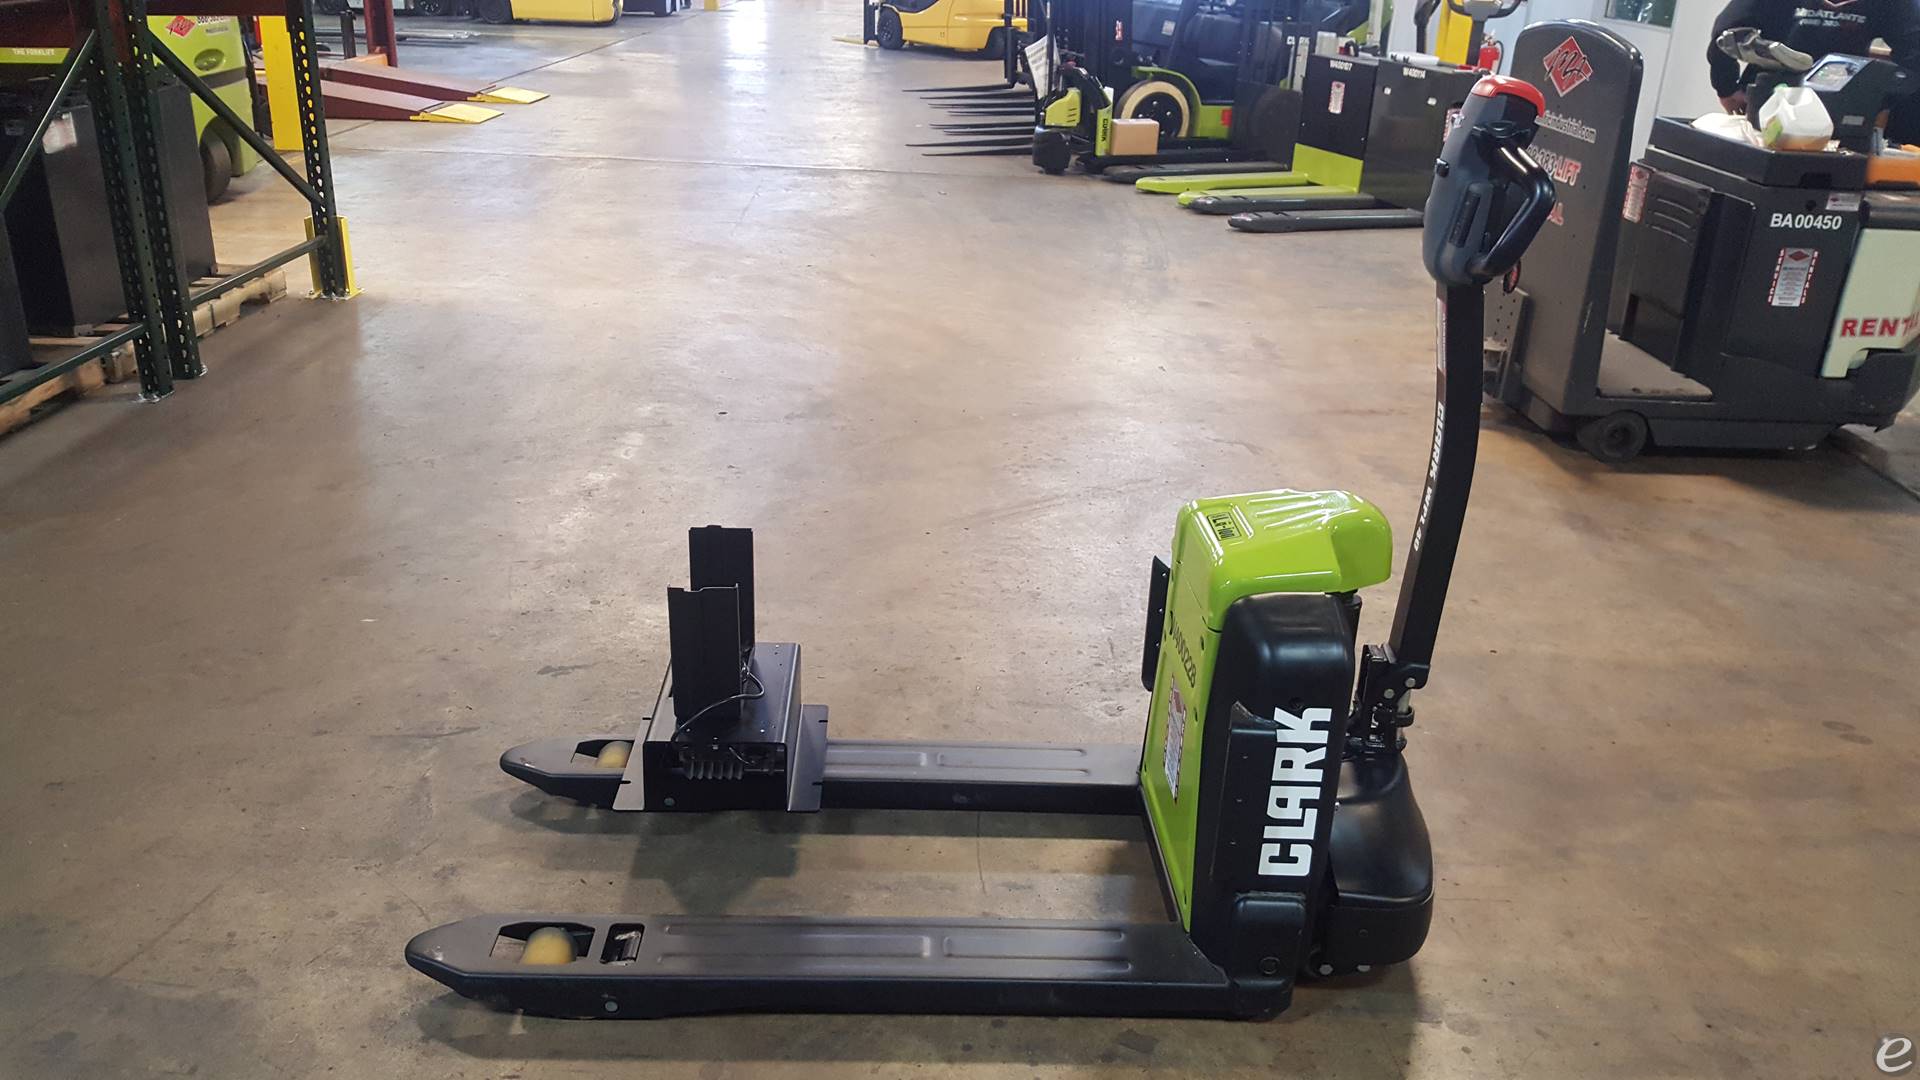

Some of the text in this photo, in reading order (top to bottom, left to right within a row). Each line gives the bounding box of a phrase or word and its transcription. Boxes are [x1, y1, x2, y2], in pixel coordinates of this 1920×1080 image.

[1286, 36, 1310, 45] CLRK
[1769, 212, 1843, 231] BA00450
[1429, 400, 1445, 480] CLARK
[1258, 706, 1332, 877] CLARK
